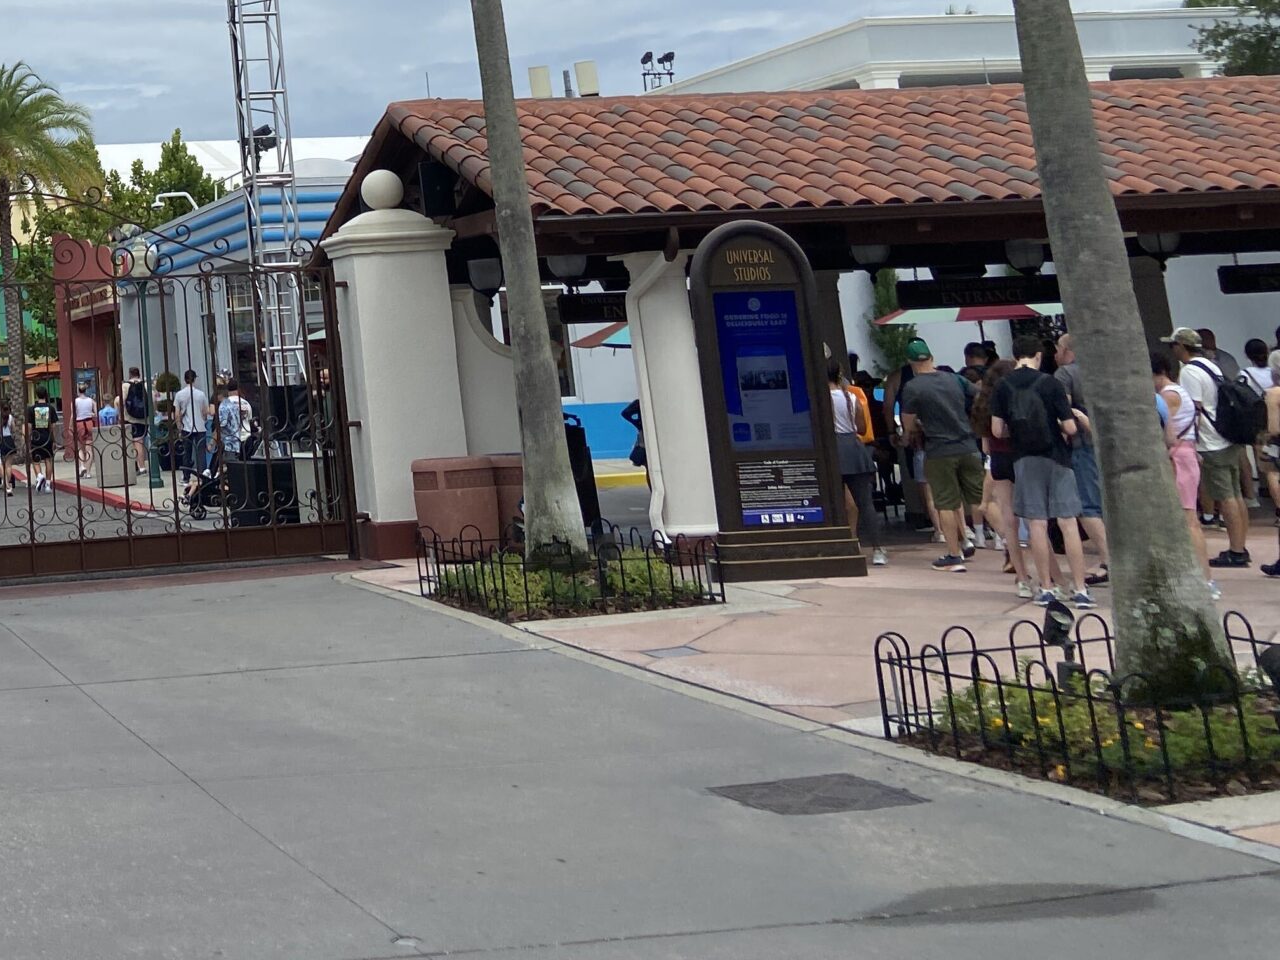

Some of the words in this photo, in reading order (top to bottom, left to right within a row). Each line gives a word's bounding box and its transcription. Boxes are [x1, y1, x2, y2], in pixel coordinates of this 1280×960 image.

[726, 248, 775, 265] UNIVERSAL
[734, 266, 772, 281] STUDIOS
[940, 288, 1024, 304] ENTRANCE
